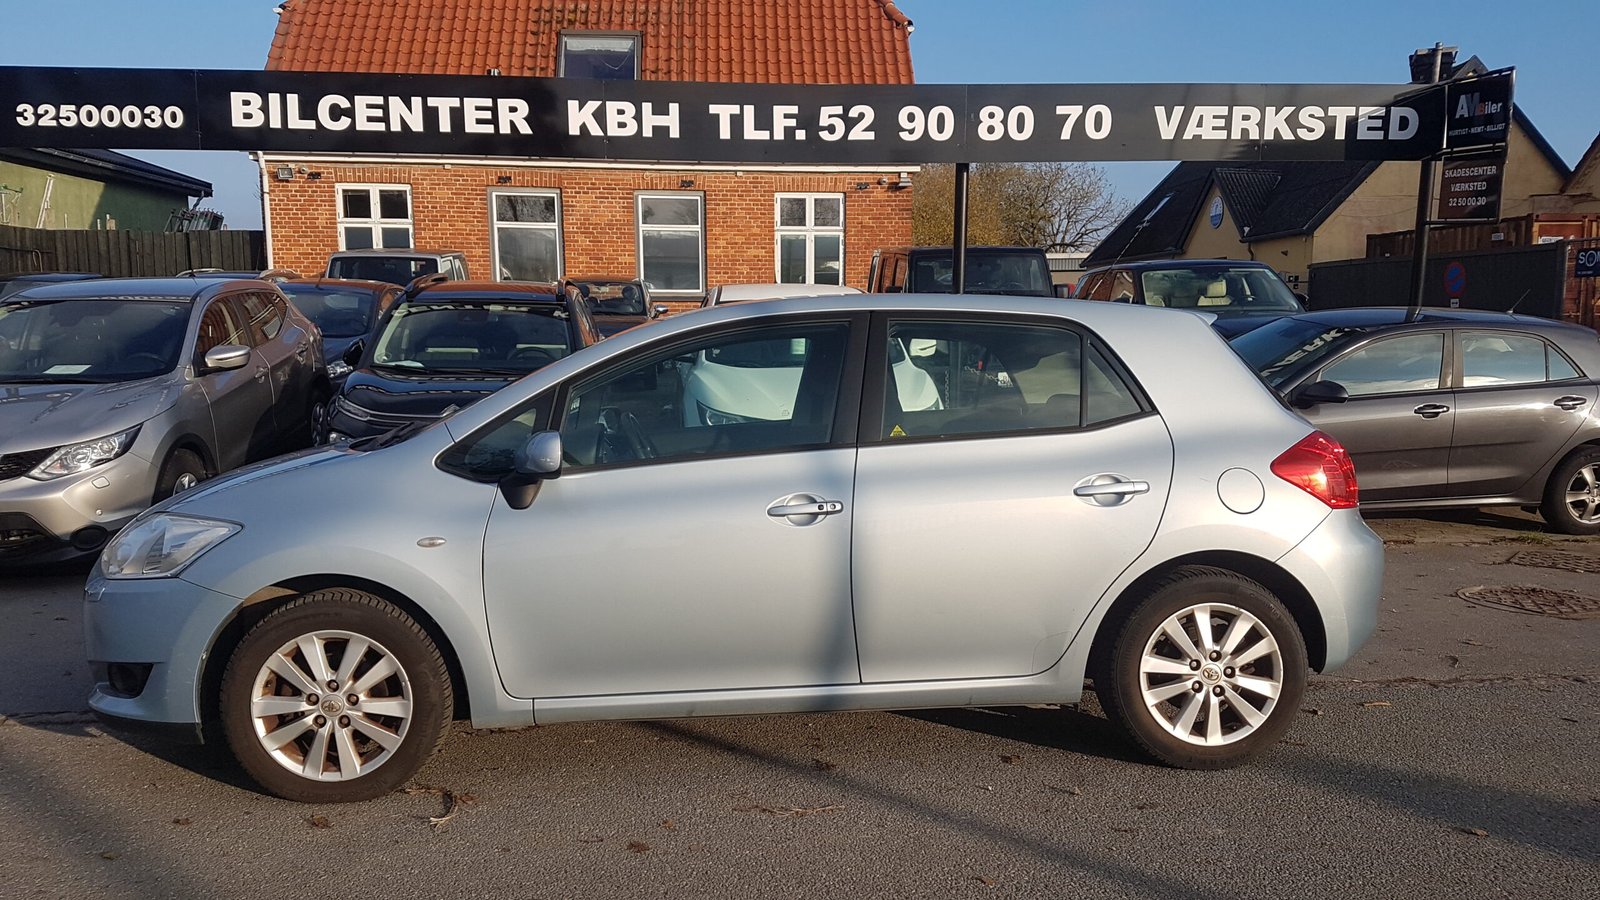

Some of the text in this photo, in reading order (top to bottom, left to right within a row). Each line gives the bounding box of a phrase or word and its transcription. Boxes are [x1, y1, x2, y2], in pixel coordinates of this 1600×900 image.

[15, 91, 1420, 142] 32500030 BILCENTER KBH TLF. 52 90 80 70 VÆRKSTED
[1444, 166, 1497, 177] SKADESCENTER
[1450, 181, 1487, 192] VÆRKSTED
